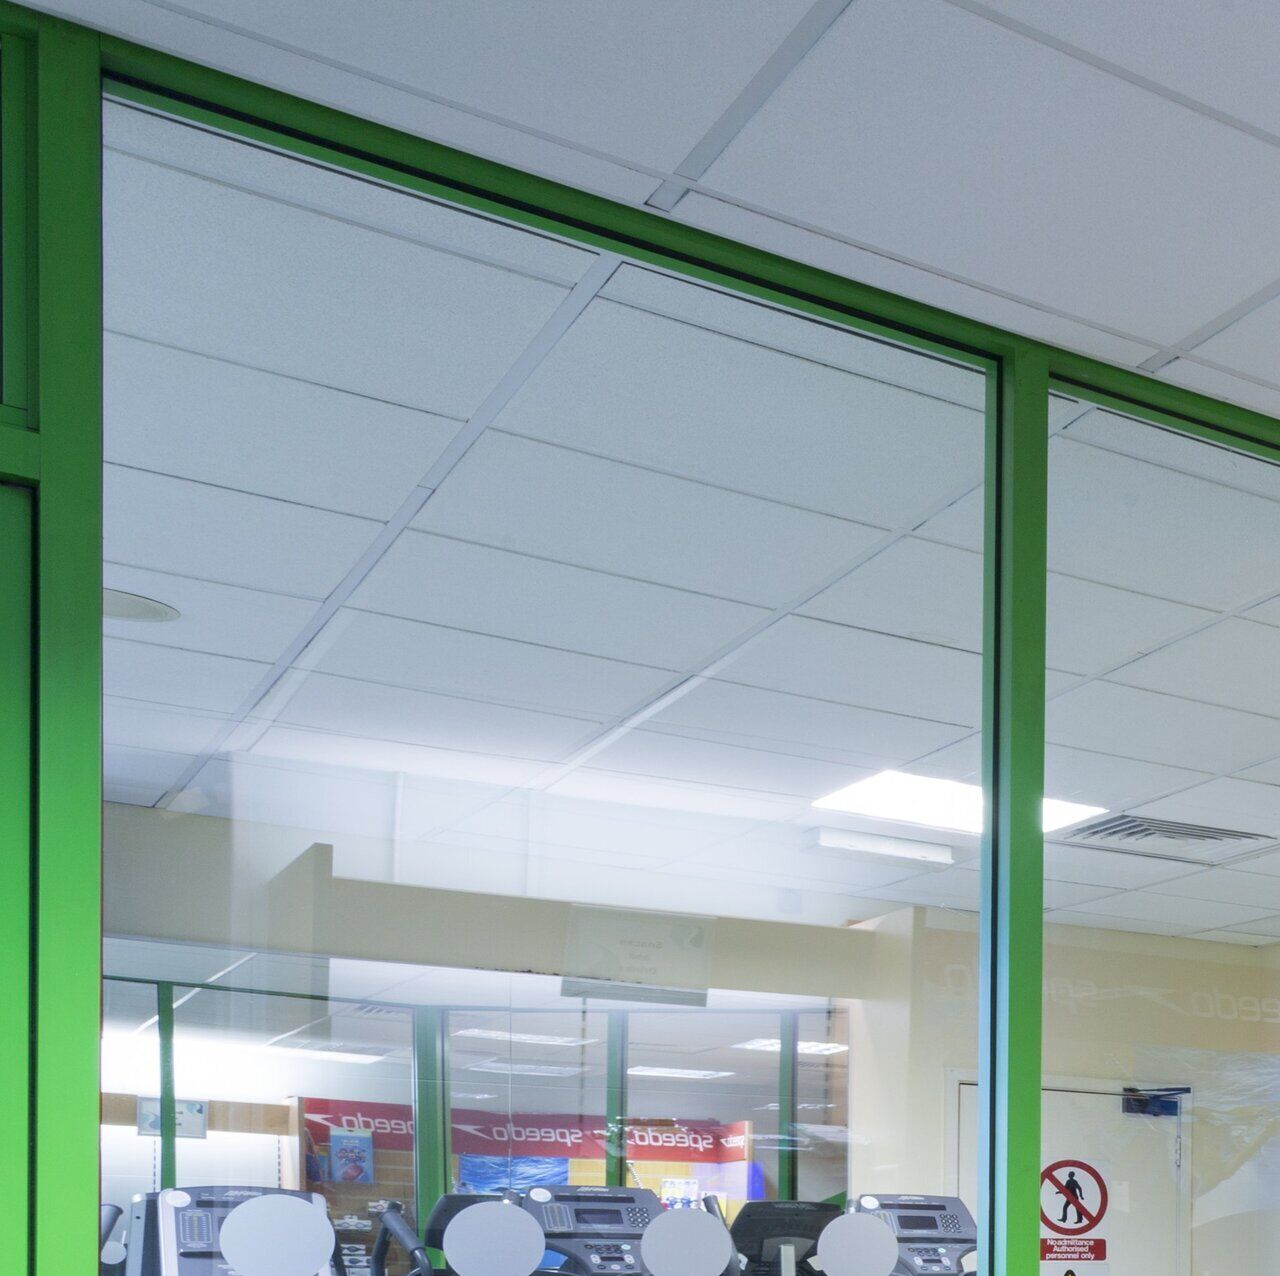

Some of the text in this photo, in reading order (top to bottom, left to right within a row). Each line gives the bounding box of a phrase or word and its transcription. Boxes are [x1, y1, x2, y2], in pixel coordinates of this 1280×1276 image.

[1058, 1238, 1094, 1246] admittance
[1046, 1252, 1095, 1260] personnel only
